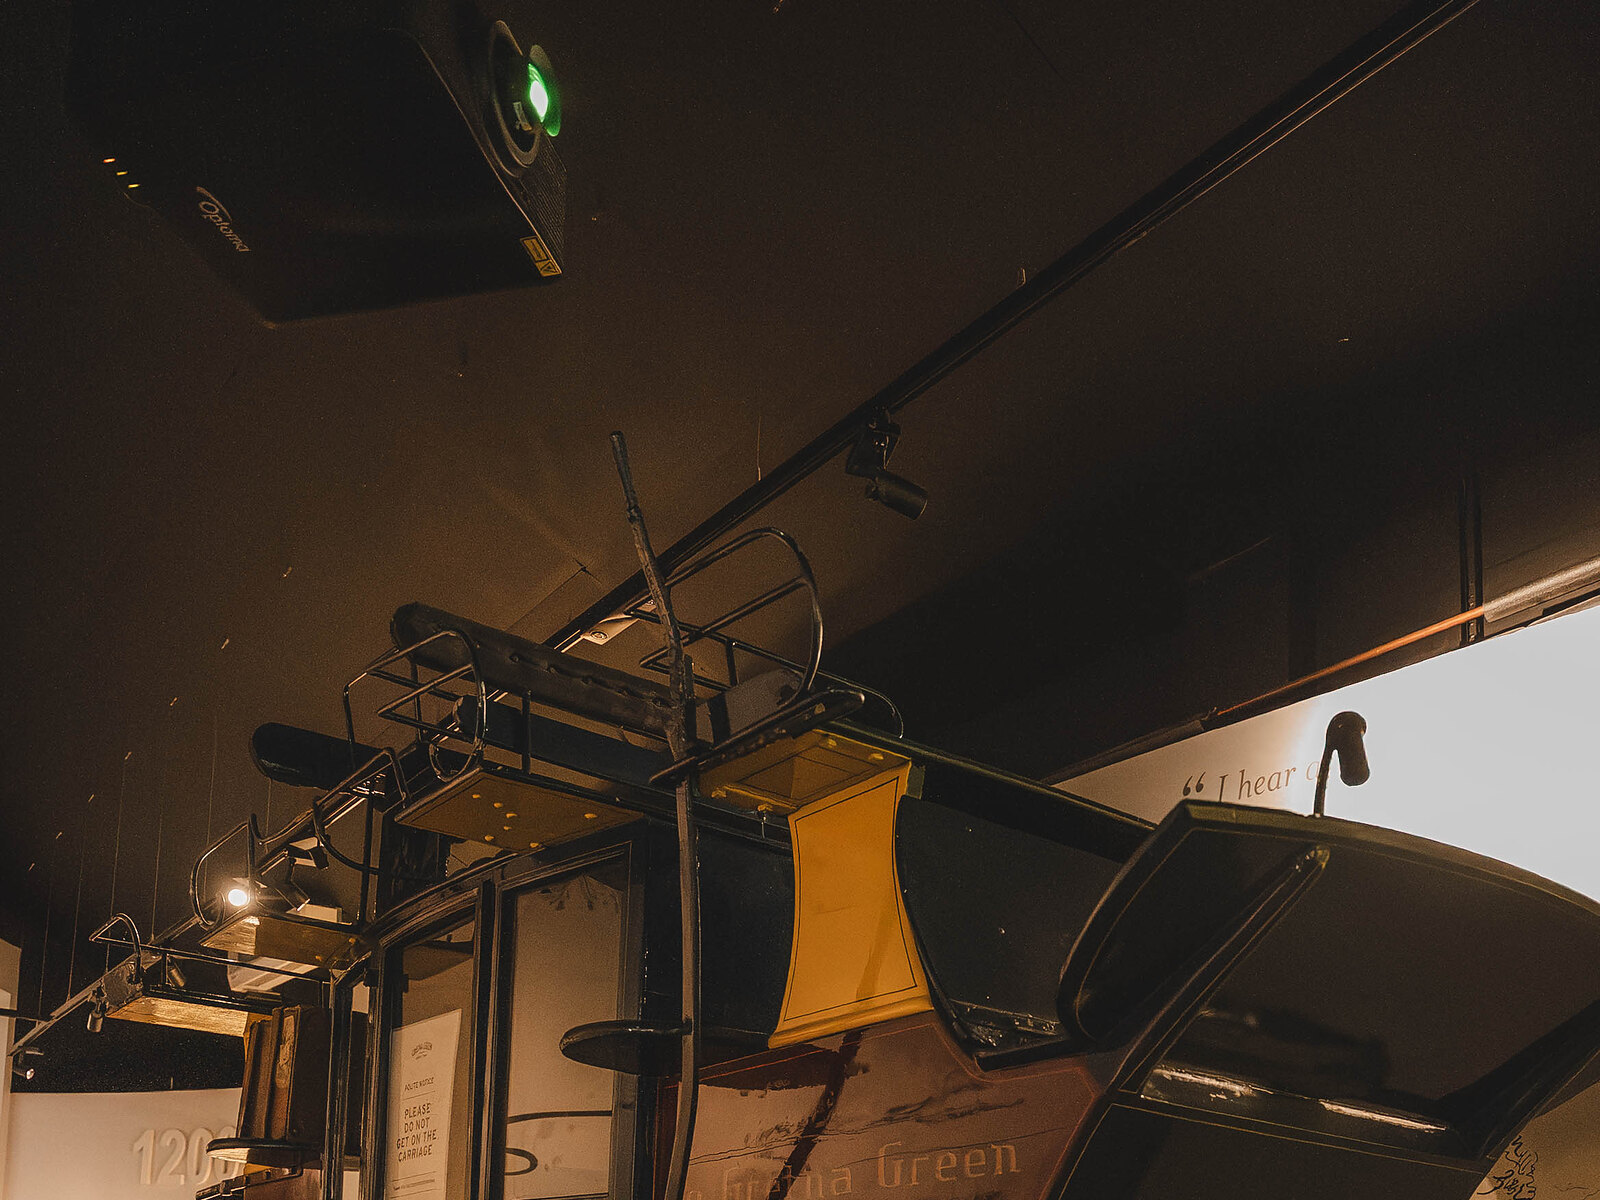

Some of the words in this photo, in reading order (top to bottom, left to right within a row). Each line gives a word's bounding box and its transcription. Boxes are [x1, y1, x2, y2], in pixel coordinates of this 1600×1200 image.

[196, 187, 251, 252] Optoma
[1238, 767, 1296, 800] hear
[404, 1102, 431, 1120] PLEASE
[404, 1120, 414, 1134] DO
[415, 1117, 431, 1130] NOT
[396, 1134, 410, 1150] GET
[411, 1133, 421, 1146] ON
[423, 1129, 437, 1142] THE
[398, 1144, 433, 1163] CARRIAGE
[876, 1141, 1022, 1189] Green
